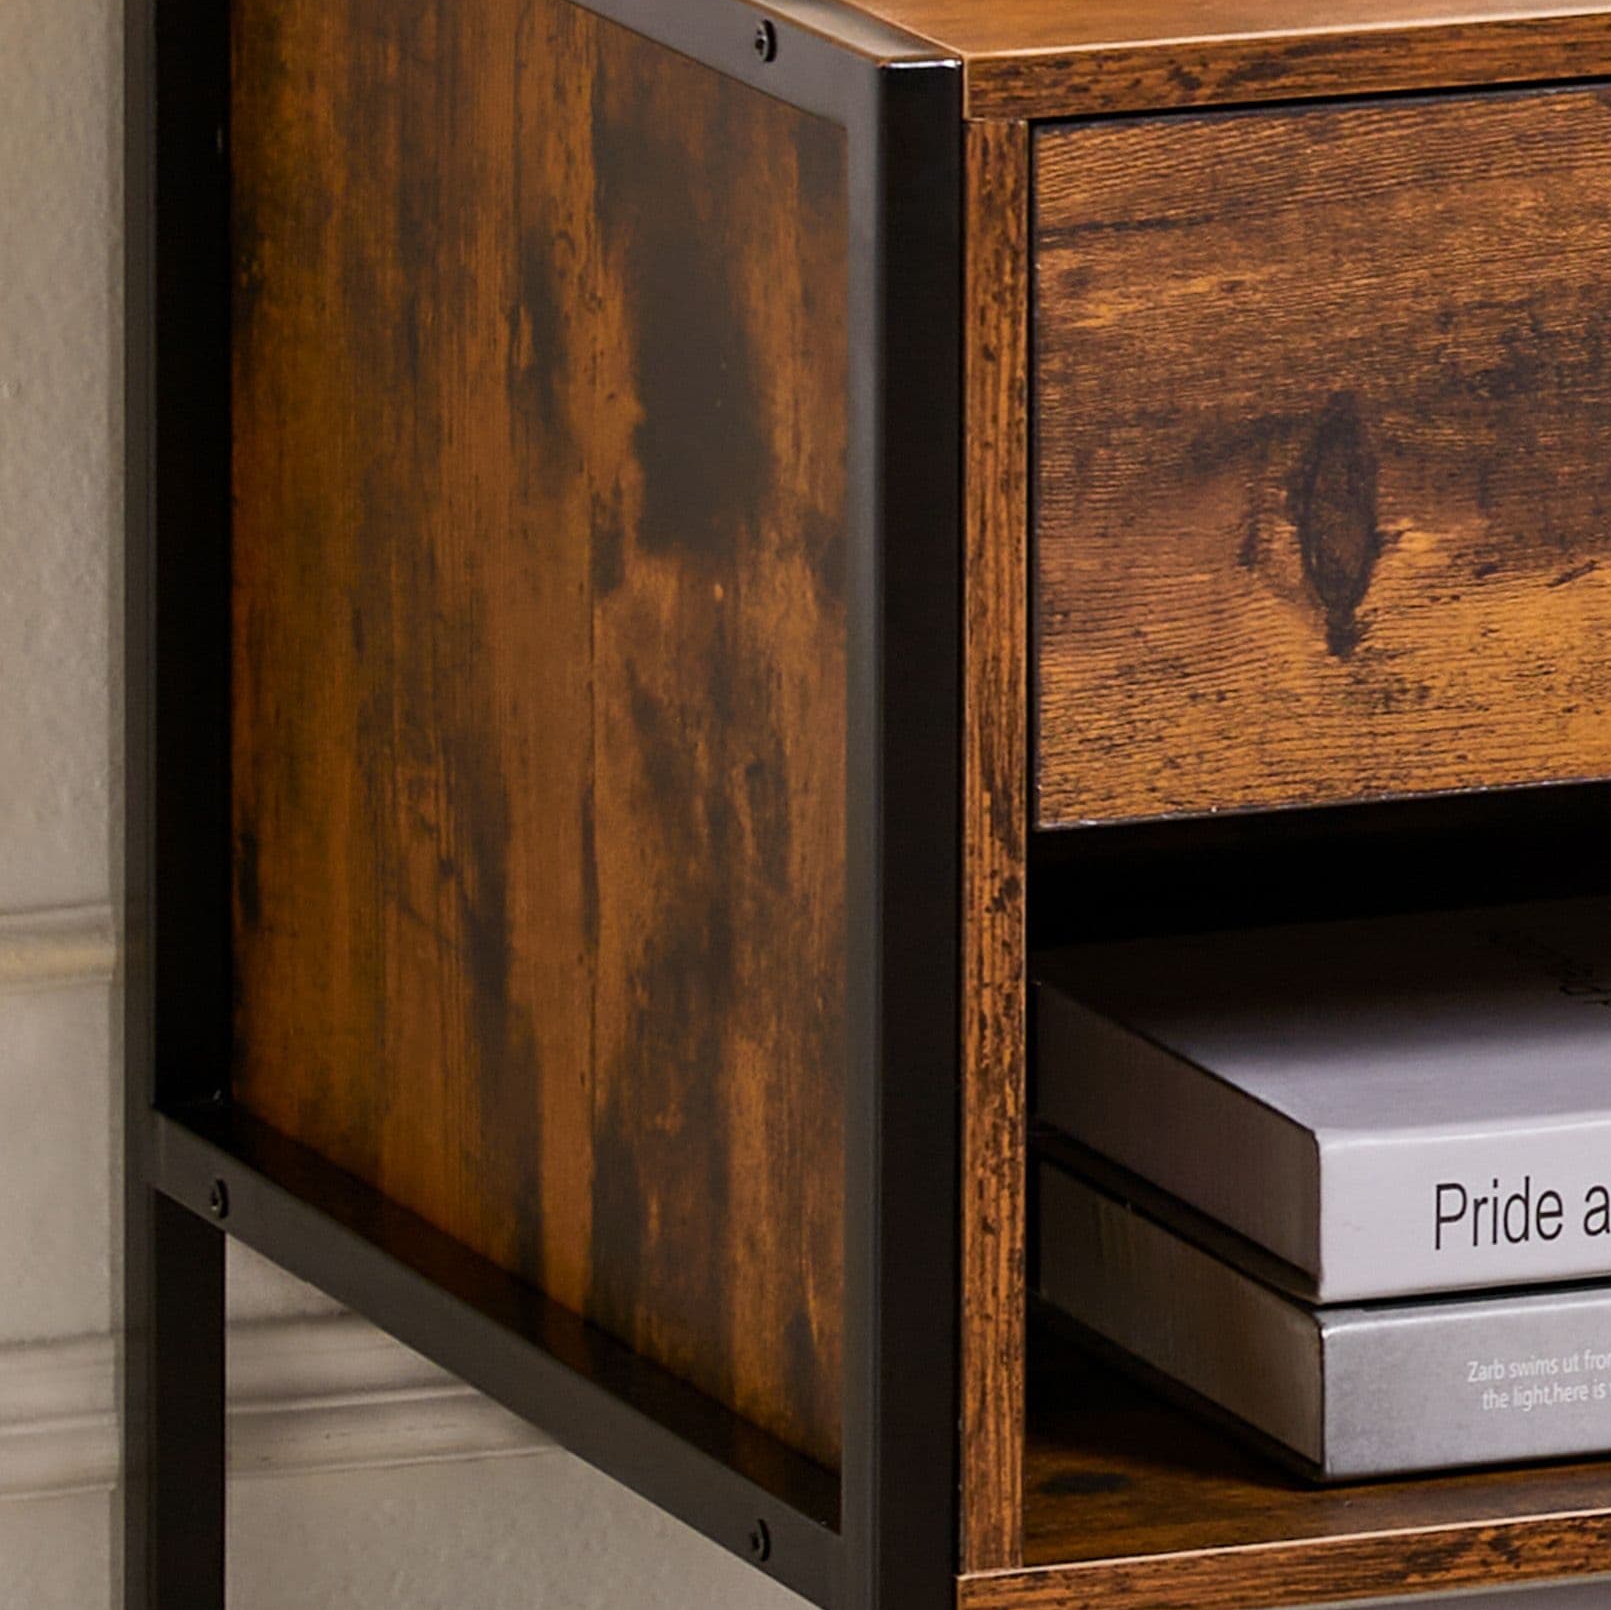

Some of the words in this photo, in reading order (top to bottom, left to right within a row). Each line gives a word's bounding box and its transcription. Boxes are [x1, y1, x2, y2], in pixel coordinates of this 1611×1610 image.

[1434, 1175, 1563, 1250] Pride
[1467, 1358, 1505, 1382] Zarb
[1509, 1355, 1559, 1378] swims
[1482, 1388, 1509, 1410] the
[1592, 1378, 1606, 1399] is
